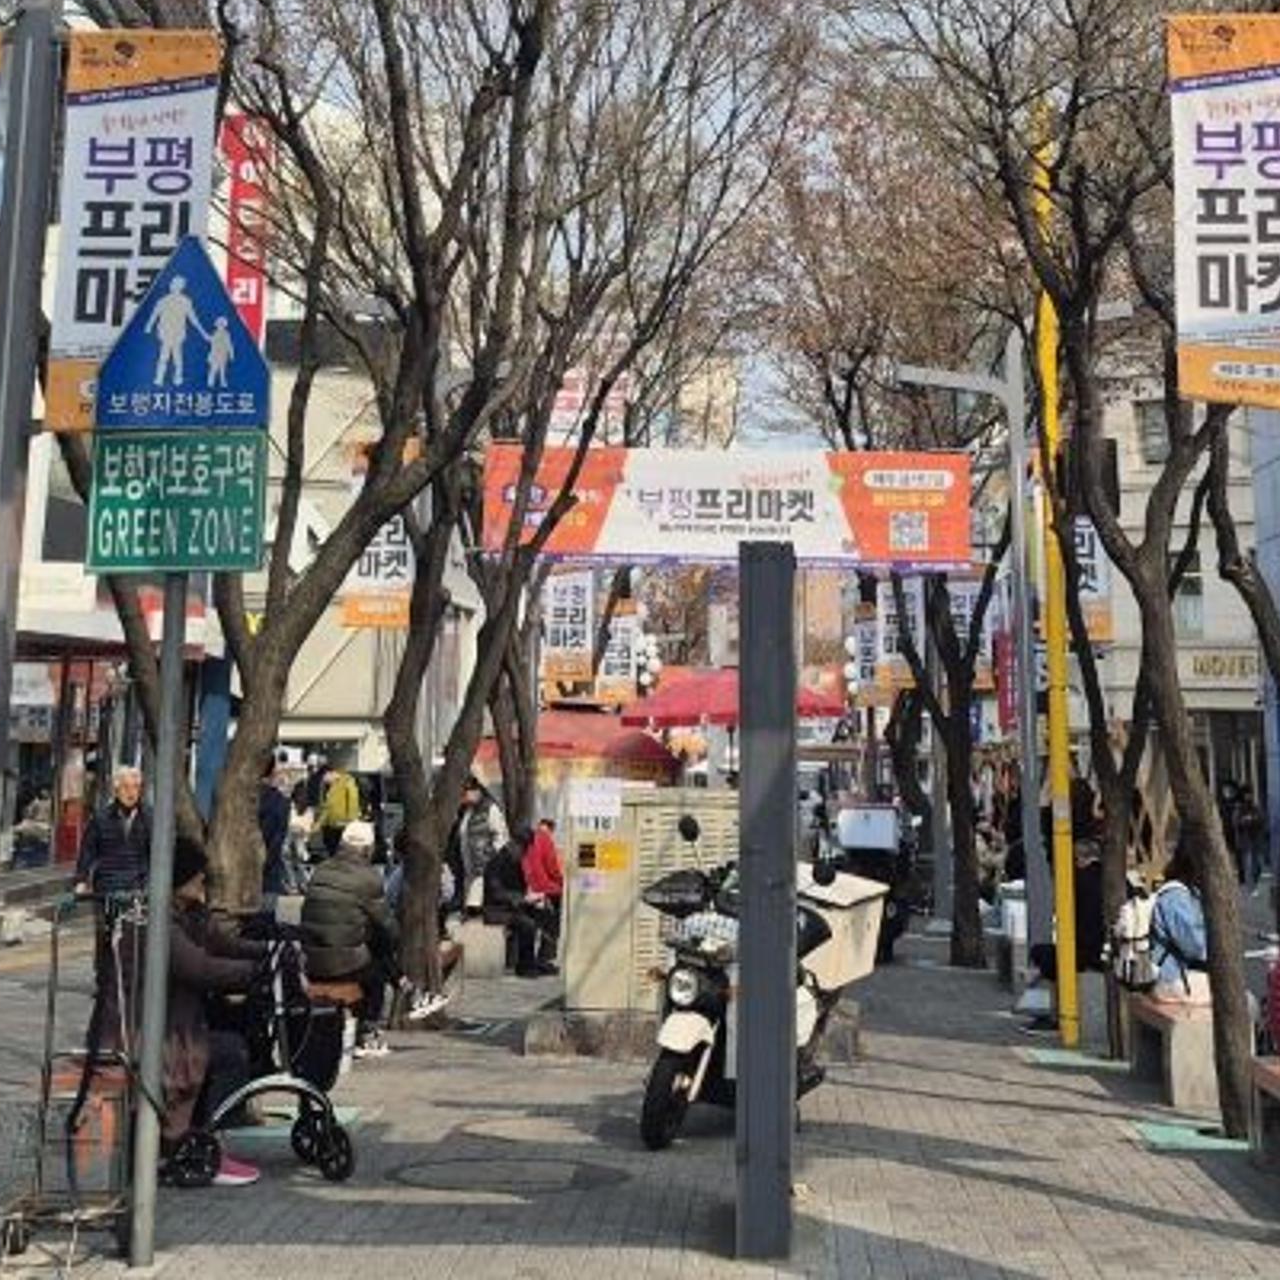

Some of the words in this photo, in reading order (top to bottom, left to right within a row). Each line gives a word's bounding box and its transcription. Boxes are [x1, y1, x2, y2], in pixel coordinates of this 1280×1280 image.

[84, 136, 193, 196] 부평
[78, 201, 191, 258] 프리
[107, 391, 257, 417] 보행자전용도로
[101, 443, 256, 500] 보행자보호구역
[98, 507, 178, 557] GREEN
[187, 506, 254, 557] ZONE
